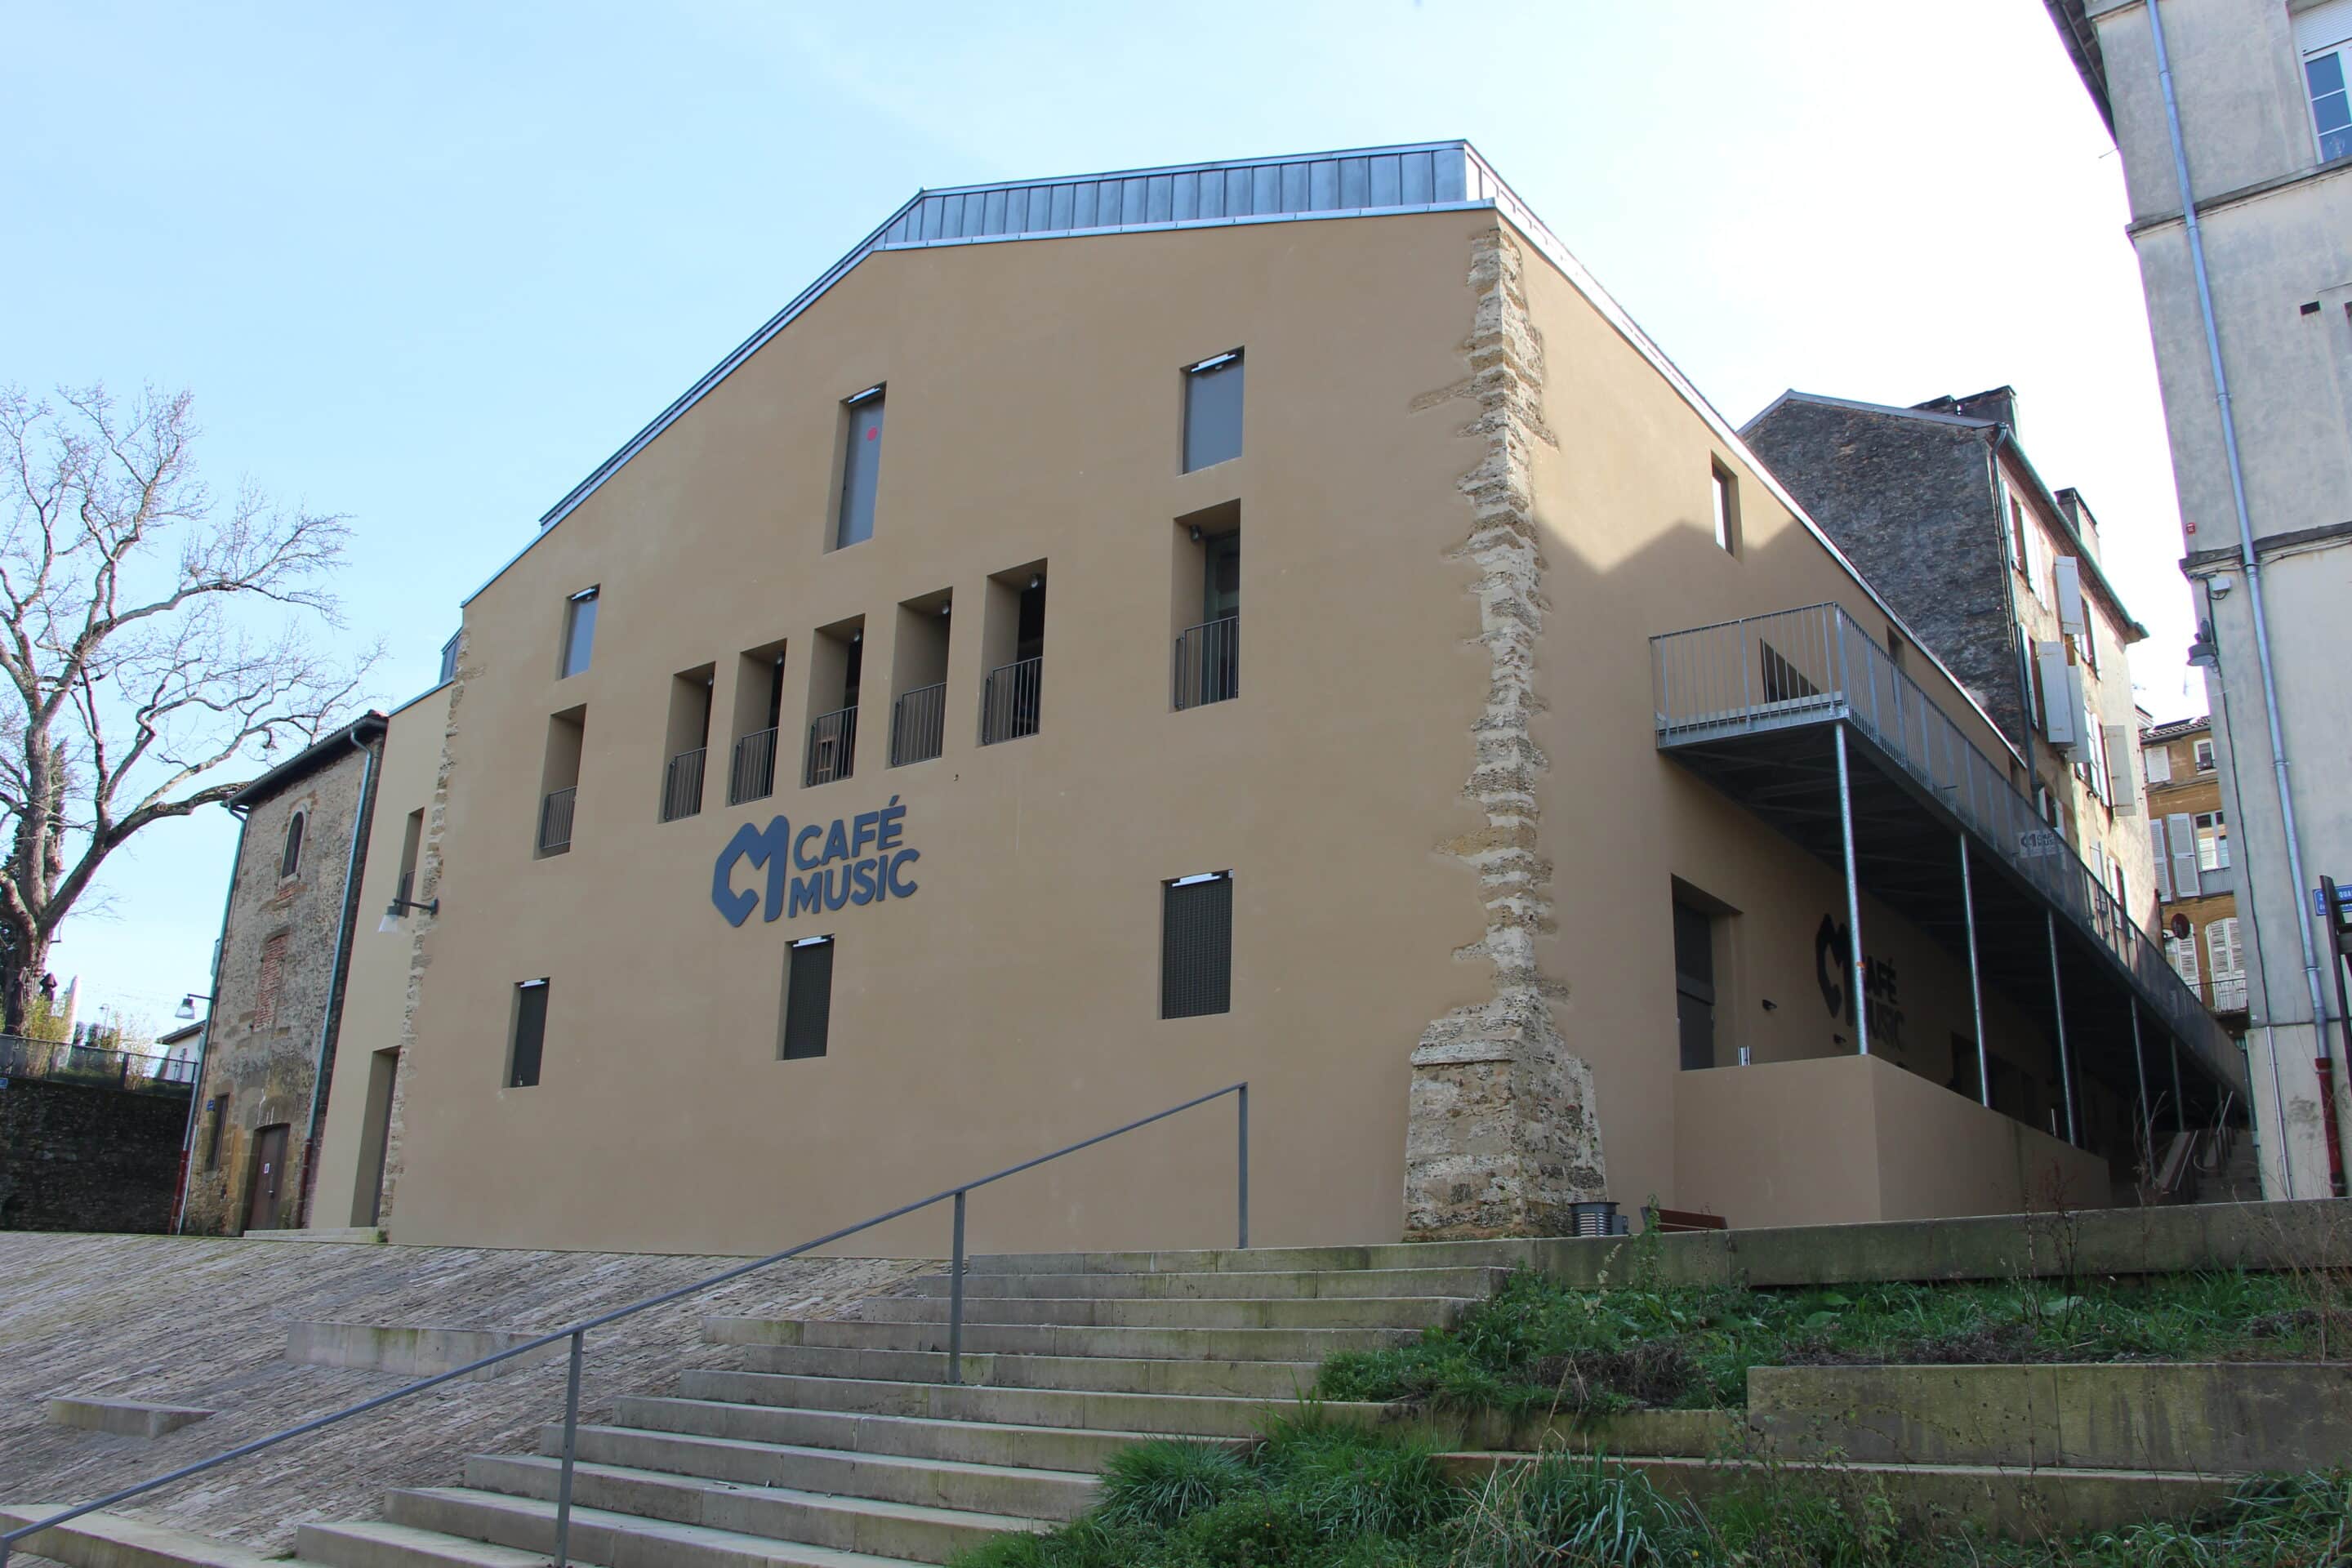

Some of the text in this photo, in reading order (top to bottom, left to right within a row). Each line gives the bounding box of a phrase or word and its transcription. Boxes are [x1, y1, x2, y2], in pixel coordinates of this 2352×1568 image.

[793, 795, 906, 871] CAFÉ
[788, 848, 920, 919] MUSIC
[2338, 889, 2352, 898] QUA
[1861, 956, 1899, 1005] AFÉ
[1863, 996, 1905, 1052] USIC
